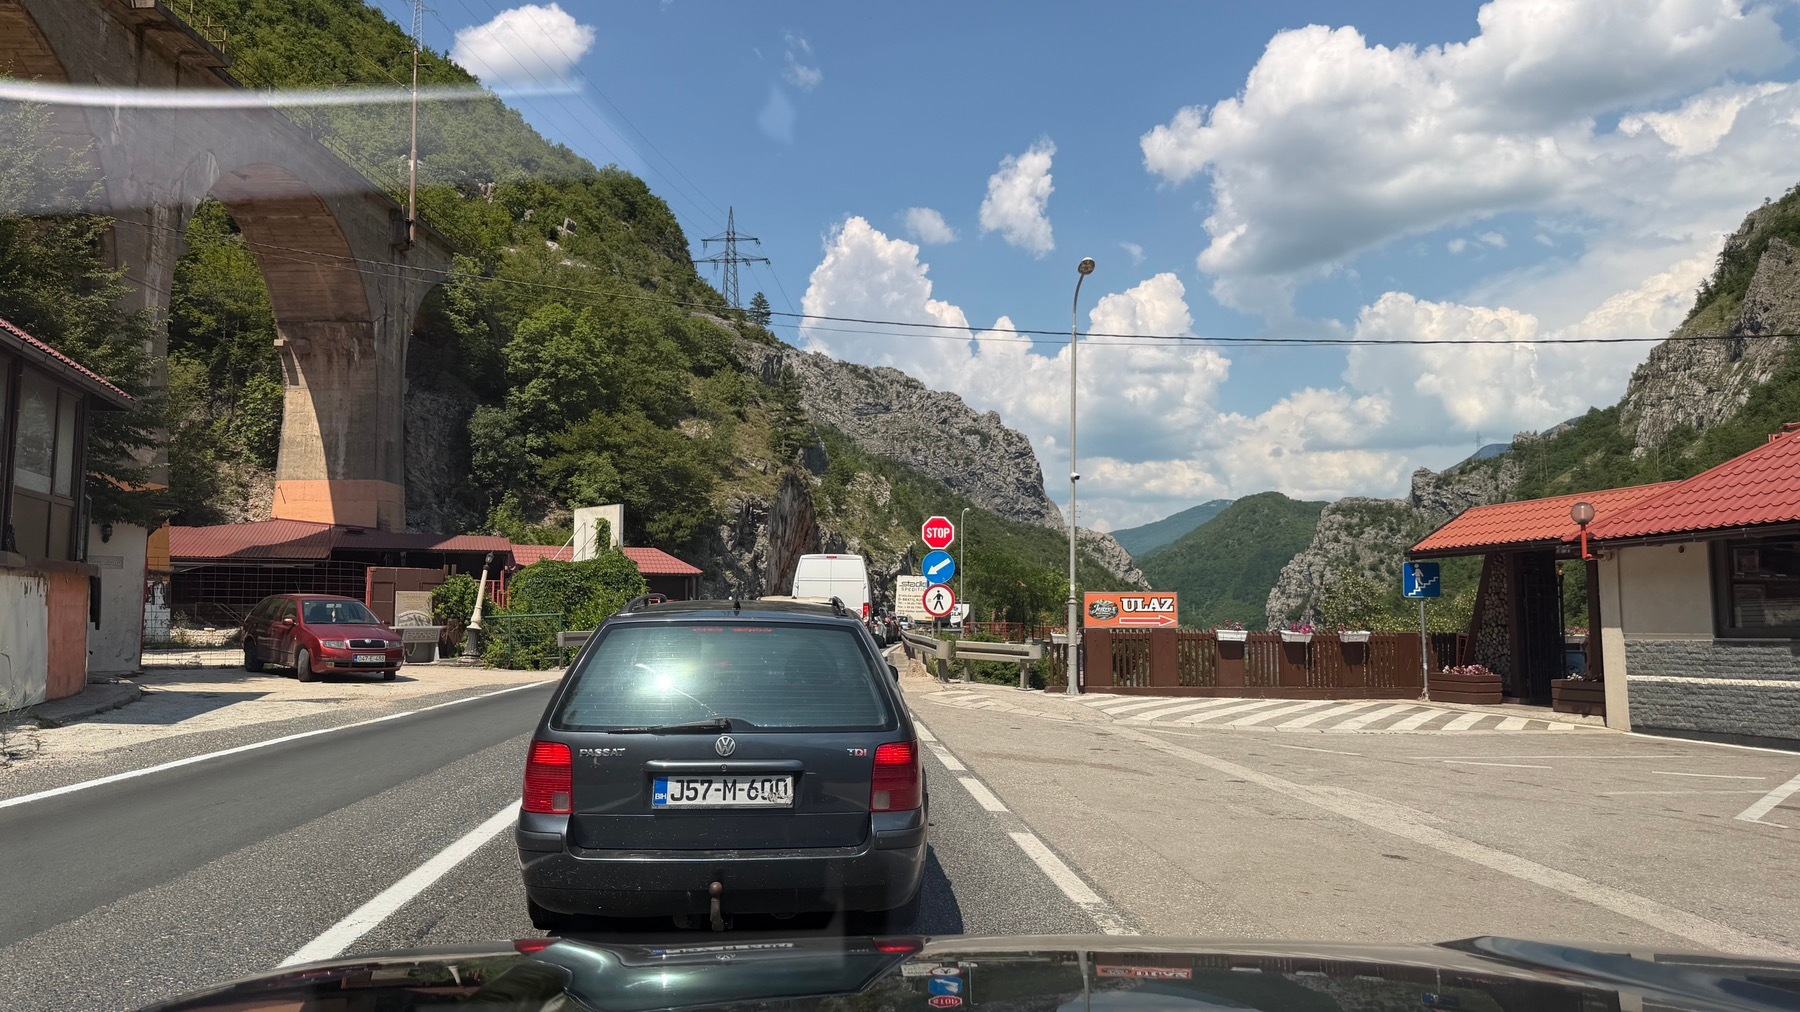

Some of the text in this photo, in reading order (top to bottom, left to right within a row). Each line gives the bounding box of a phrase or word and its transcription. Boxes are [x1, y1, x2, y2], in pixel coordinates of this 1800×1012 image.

[926, 527, 950, 538] STOP
[1120, 597, 1174, 613] ULAZ
[579, 748, 626, 757] PASSAT
[846, 748, 868, 757] TDI
